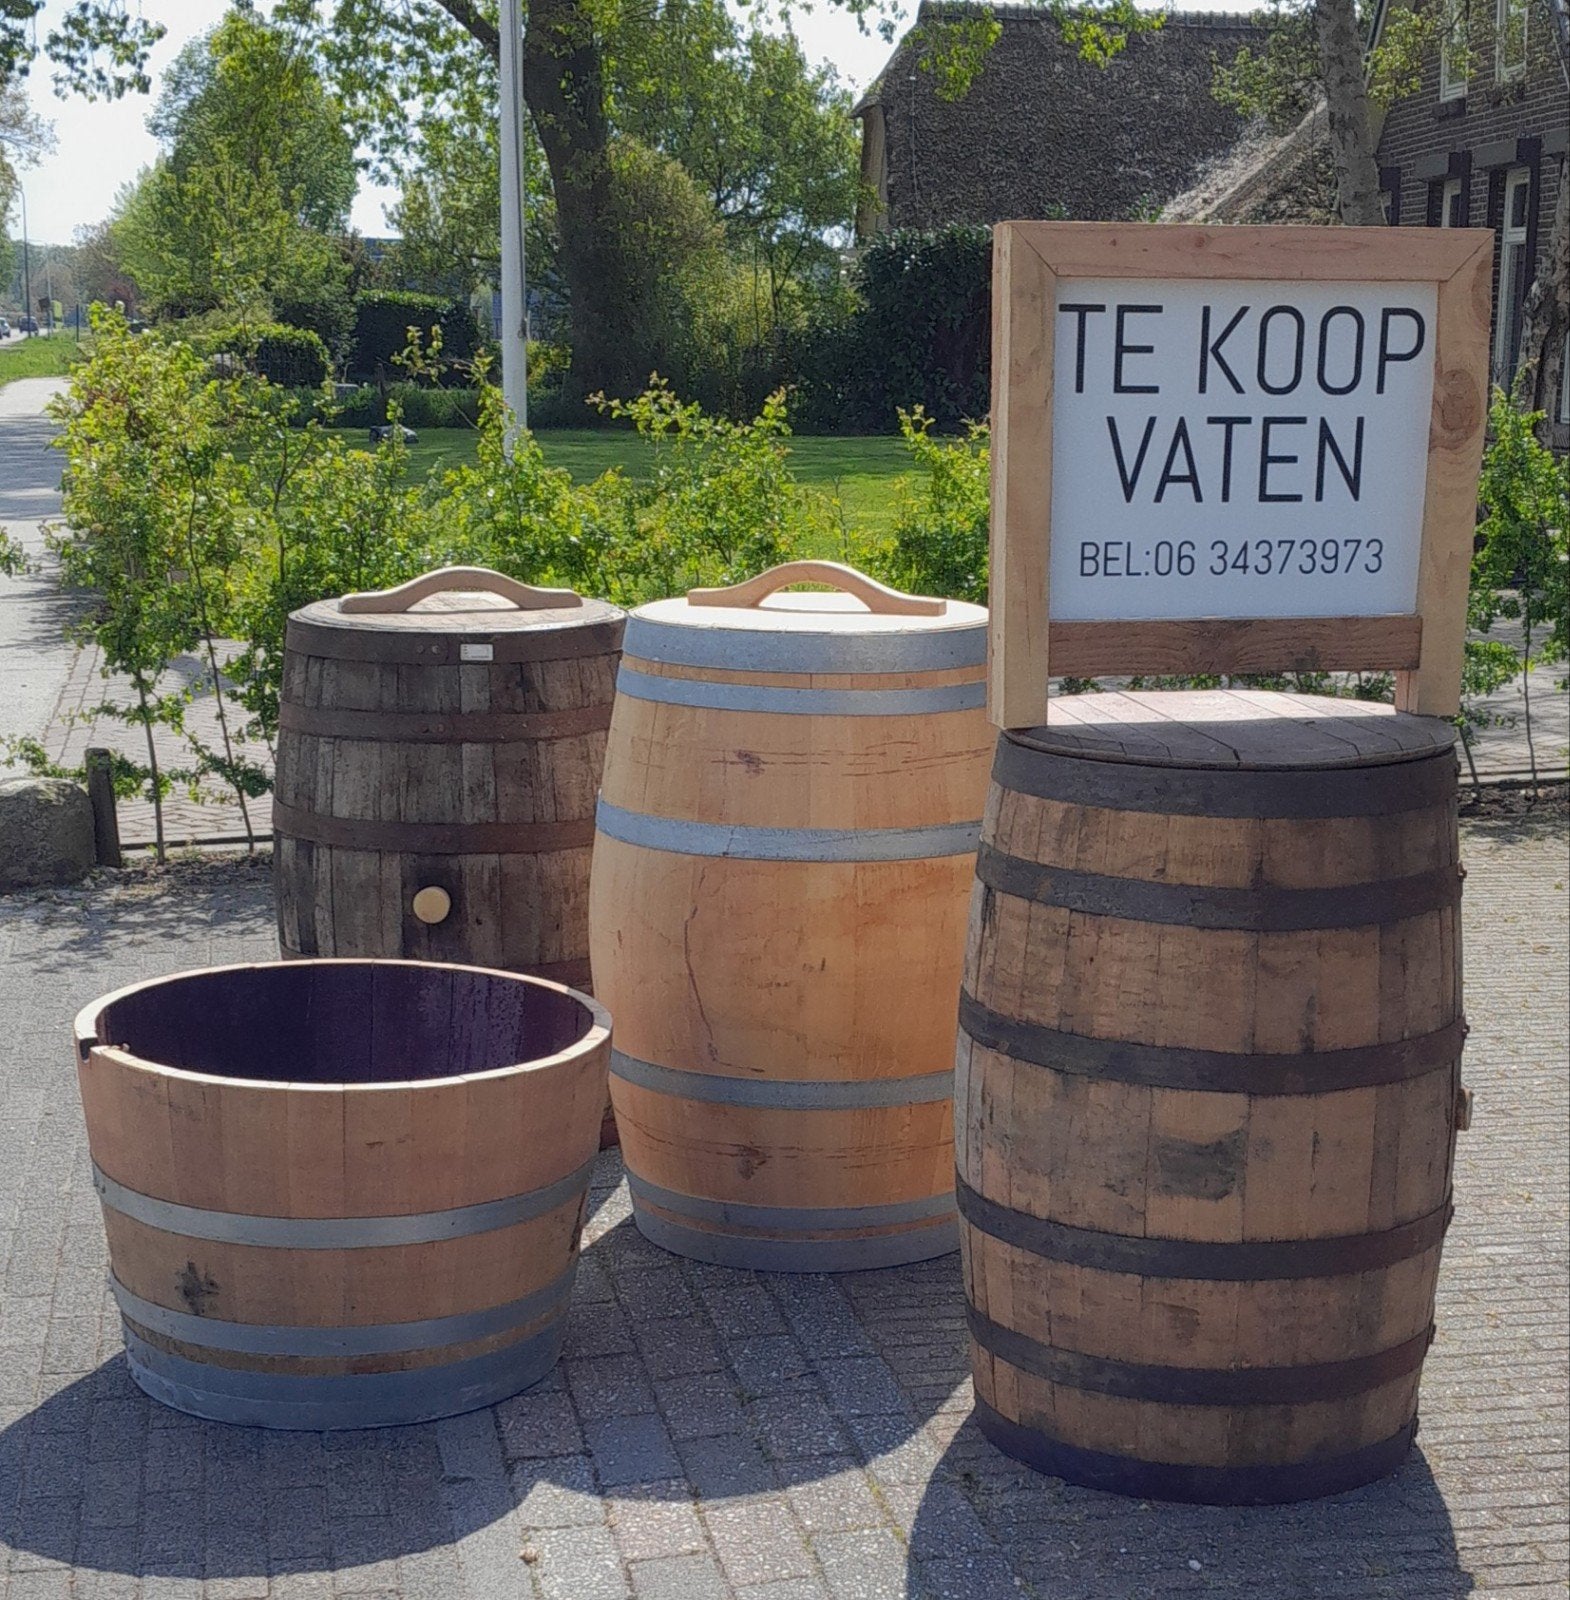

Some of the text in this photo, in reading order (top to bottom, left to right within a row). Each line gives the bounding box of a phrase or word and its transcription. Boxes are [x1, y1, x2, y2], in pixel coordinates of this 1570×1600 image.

[1057, 302, 1426, 397] TE KOOP
[1105, 415, 1366, 504] VATEN
[1209, 538, 1384, 576] 34373973
